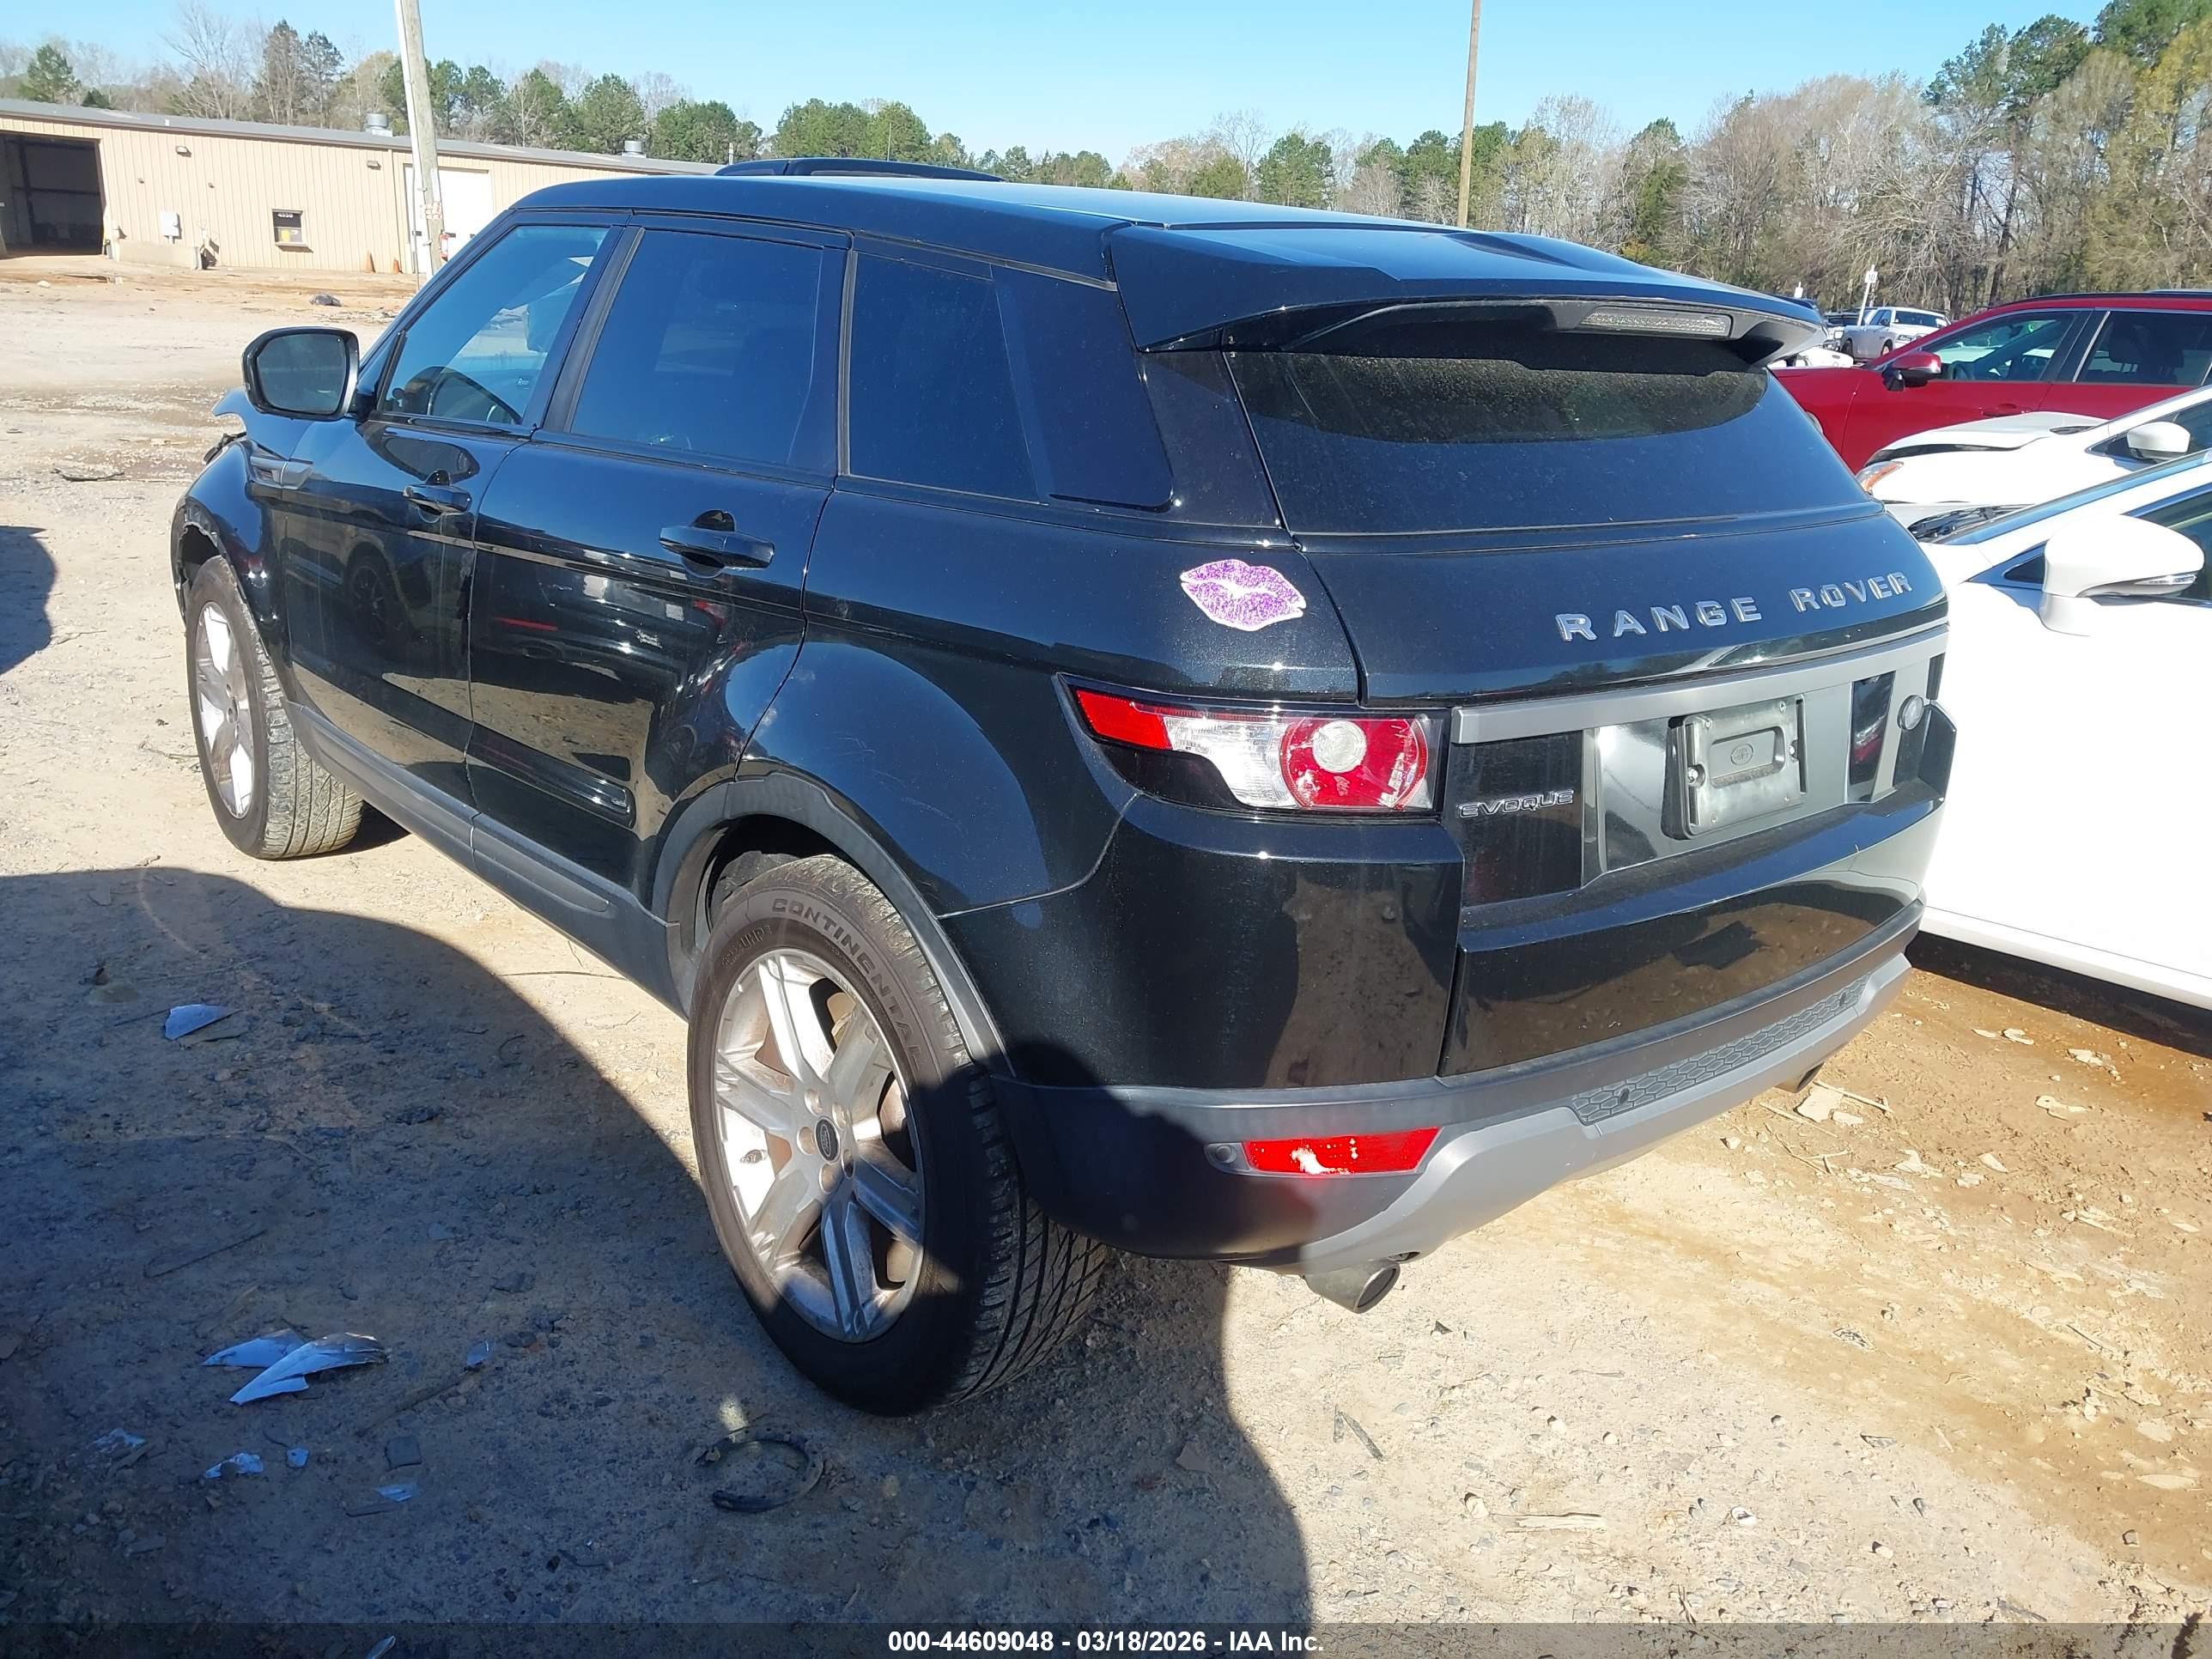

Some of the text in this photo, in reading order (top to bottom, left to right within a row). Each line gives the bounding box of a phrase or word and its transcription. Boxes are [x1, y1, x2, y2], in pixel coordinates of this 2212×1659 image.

[1555, 571, 1913, 642] RANGE ROVER
[1457, 788, 1575, 818] EVOQUE
[772, 897, 922, 1072] CONTINENTAL
